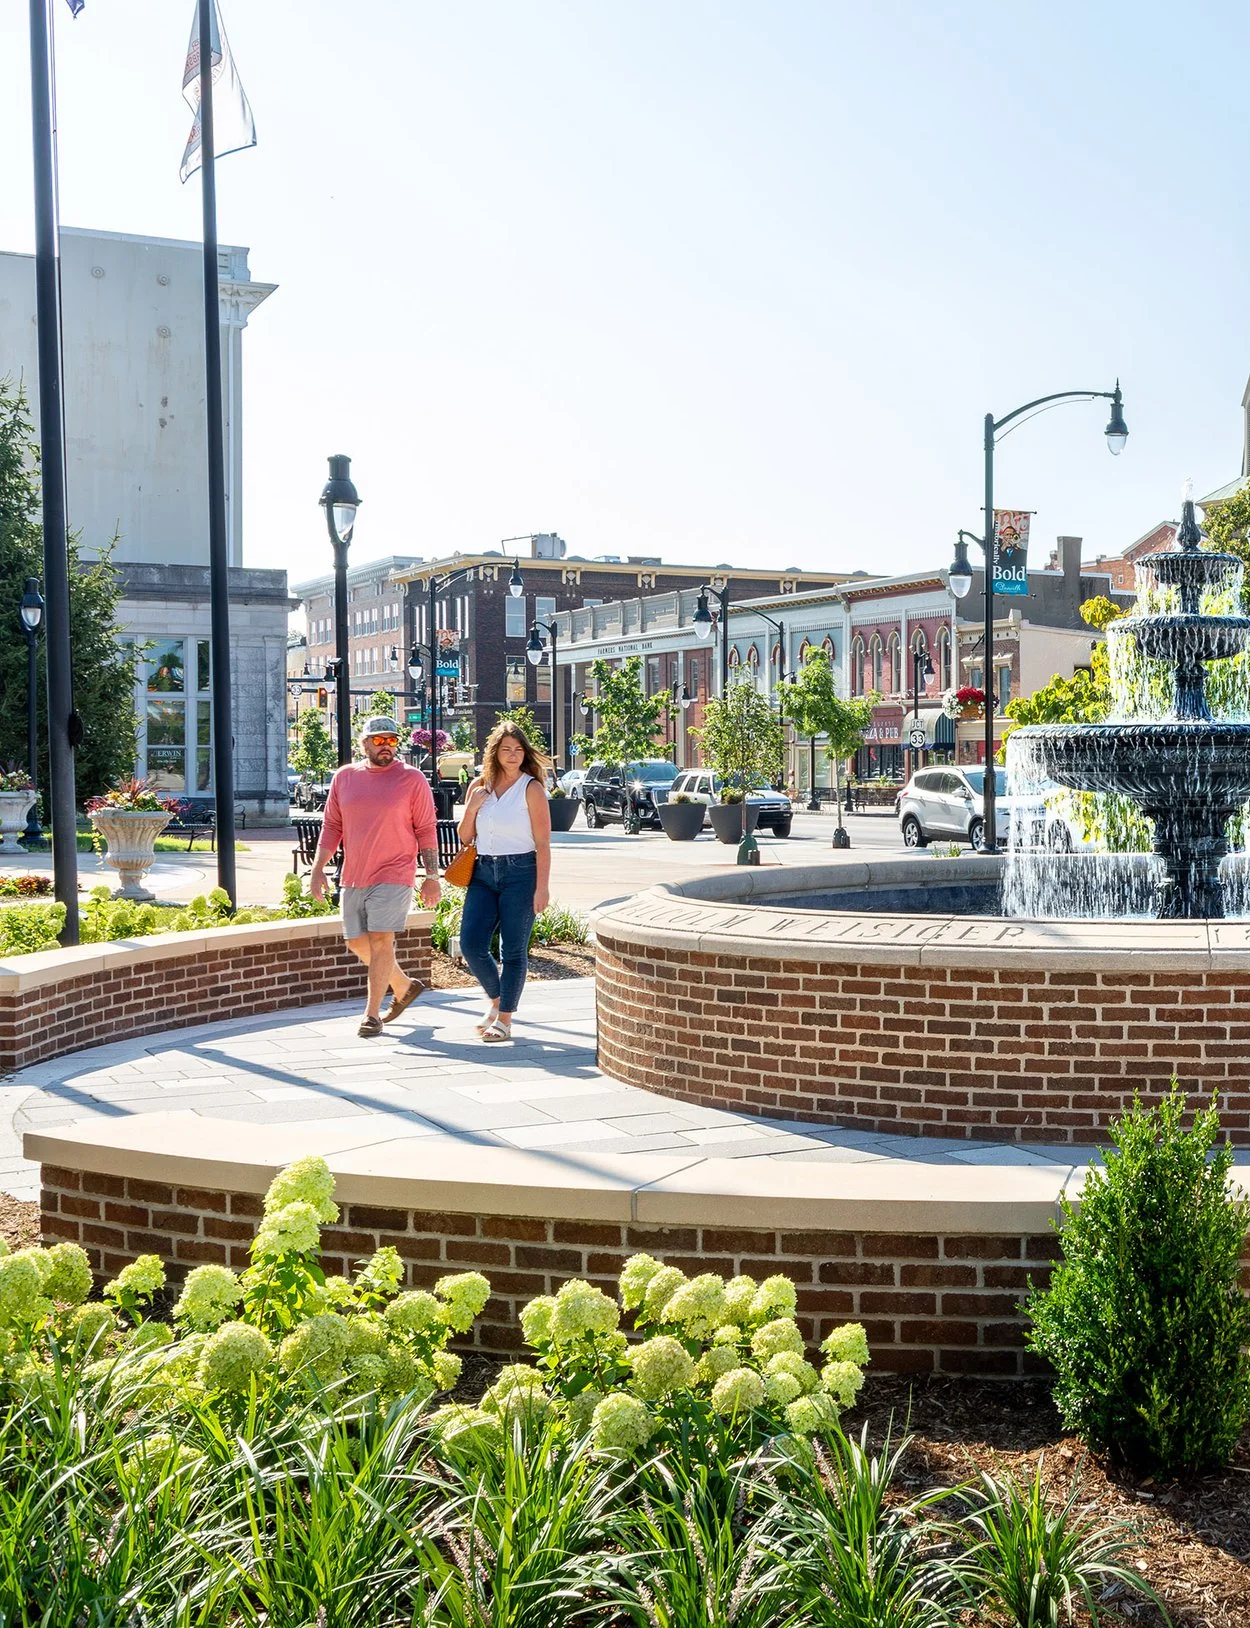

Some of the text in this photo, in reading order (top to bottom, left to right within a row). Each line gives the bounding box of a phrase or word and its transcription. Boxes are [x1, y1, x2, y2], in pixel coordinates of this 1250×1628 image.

[993, 565, 1026, 582] Bold
[597, 642, 653, 655] FARMERS NATIONAL BANK
[436, 660, 459, 669] Bold
[885, 727, 899, 739] PUB
[912, 734, 924, 744] 33
[767, 917, 1027, 942] WEISIGER
